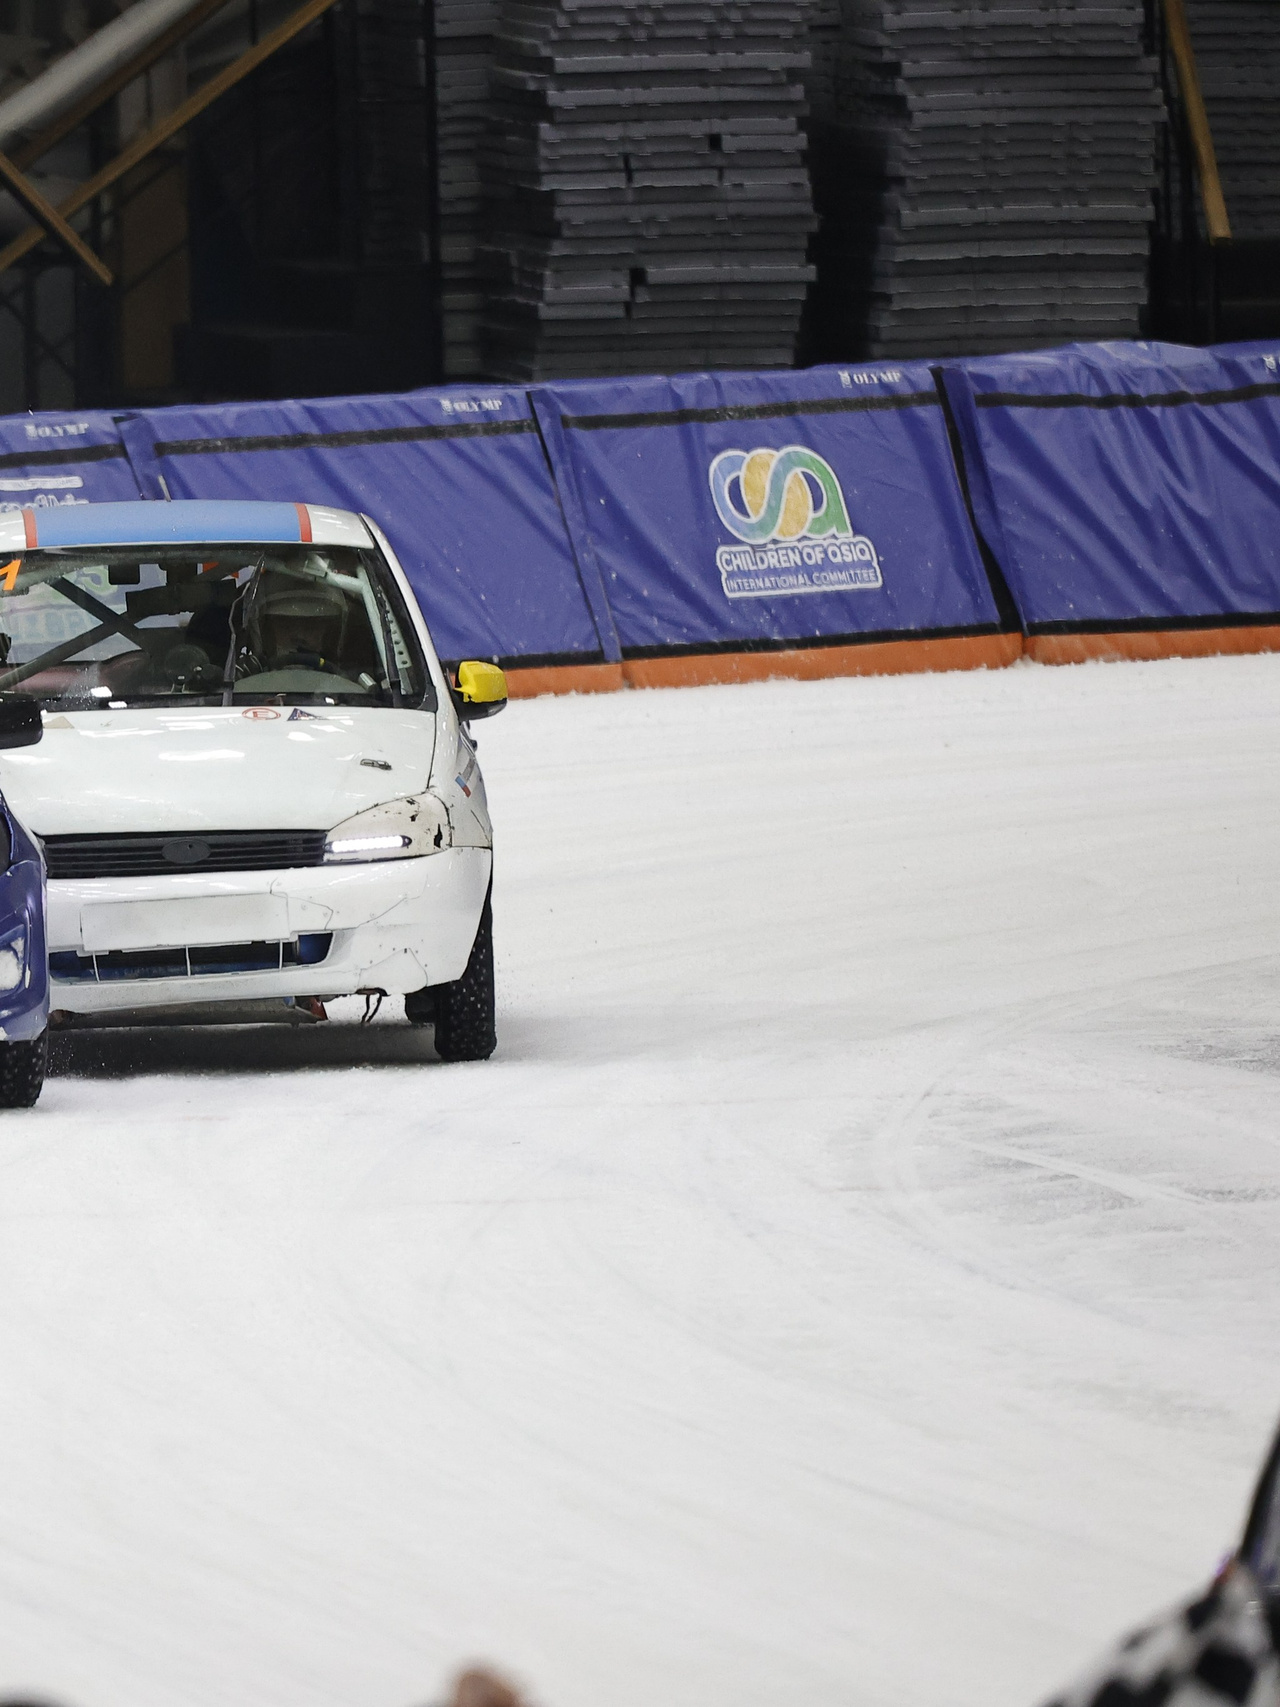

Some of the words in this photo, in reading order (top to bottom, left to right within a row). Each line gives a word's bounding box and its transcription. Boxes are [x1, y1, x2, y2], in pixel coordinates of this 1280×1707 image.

[721, 545, 802, 571] CHILDREN
[803, 544, 825, 566] OF
[727, 573, 812, 592] INTERNATIONAL
[812, 569, 876, 586] COMMITTEE
